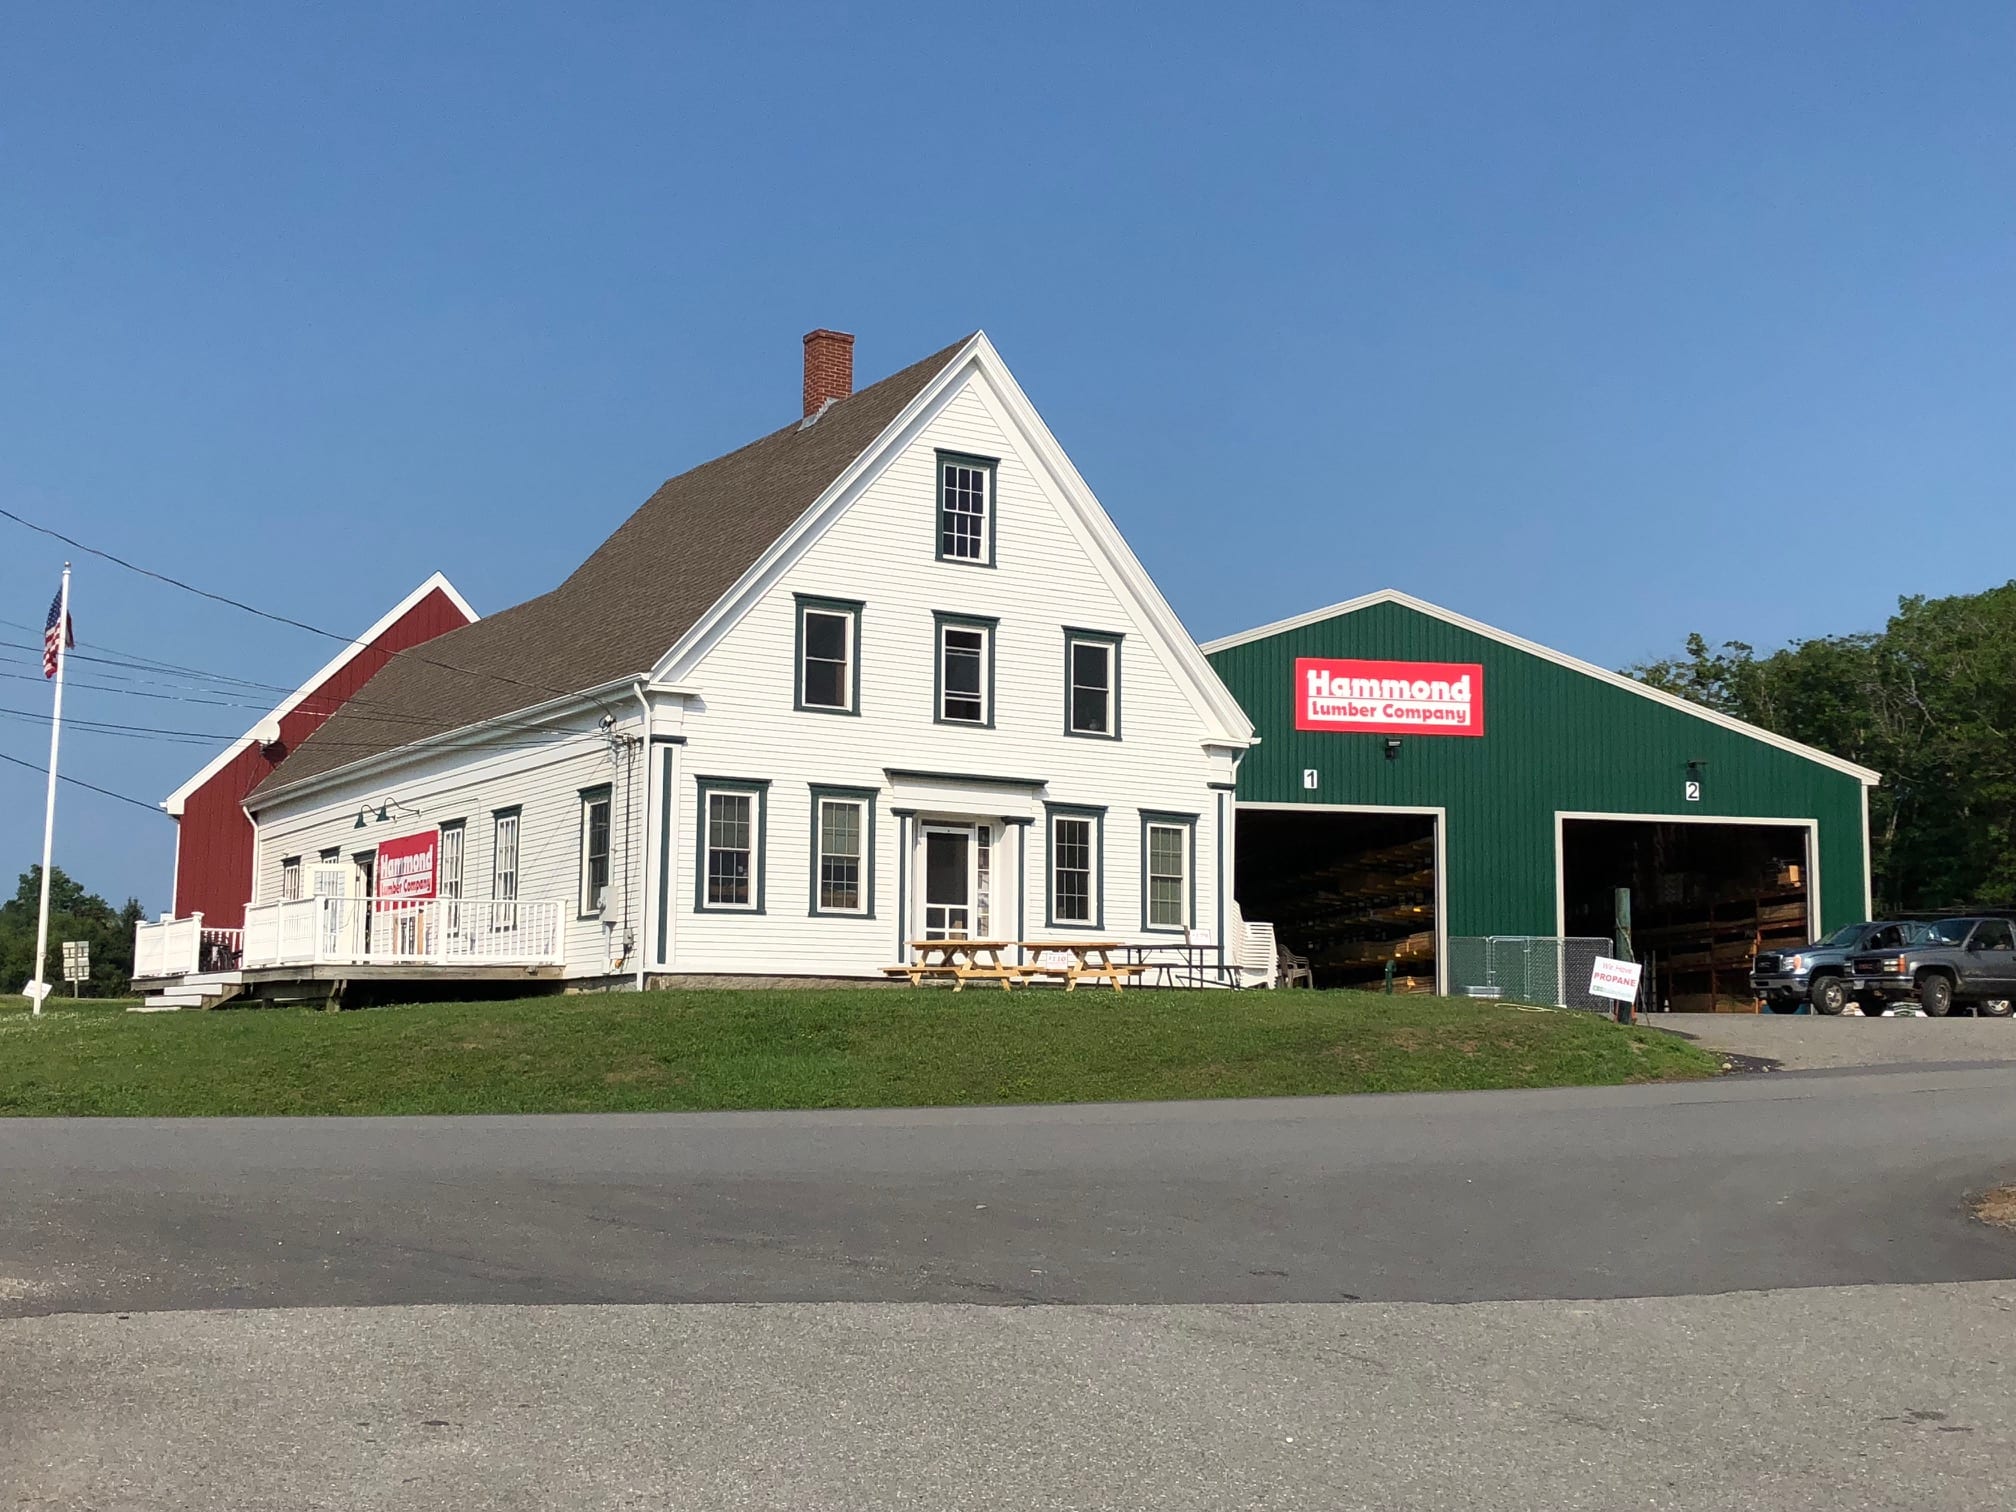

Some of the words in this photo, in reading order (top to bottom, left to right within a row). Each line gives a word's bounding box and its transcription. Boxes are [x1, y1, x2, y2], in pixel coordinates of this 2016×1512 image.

[1307, 669, 1471, 702] Hammond
[1312, 701, 1376, 718] Lumber
[1382, 704, 1466, 723] Company
[1306, 770, 1314, 788] 1
[1688, 783, 1698, 799] 2
[380, 843, 434, 879] Hammond
[403, 878, 431, 893] Company
[1602, 962, 1614, 971] We
[1616, 964, 1633, 974] Have
[1594, 972, 1637, 987] PROPANE
